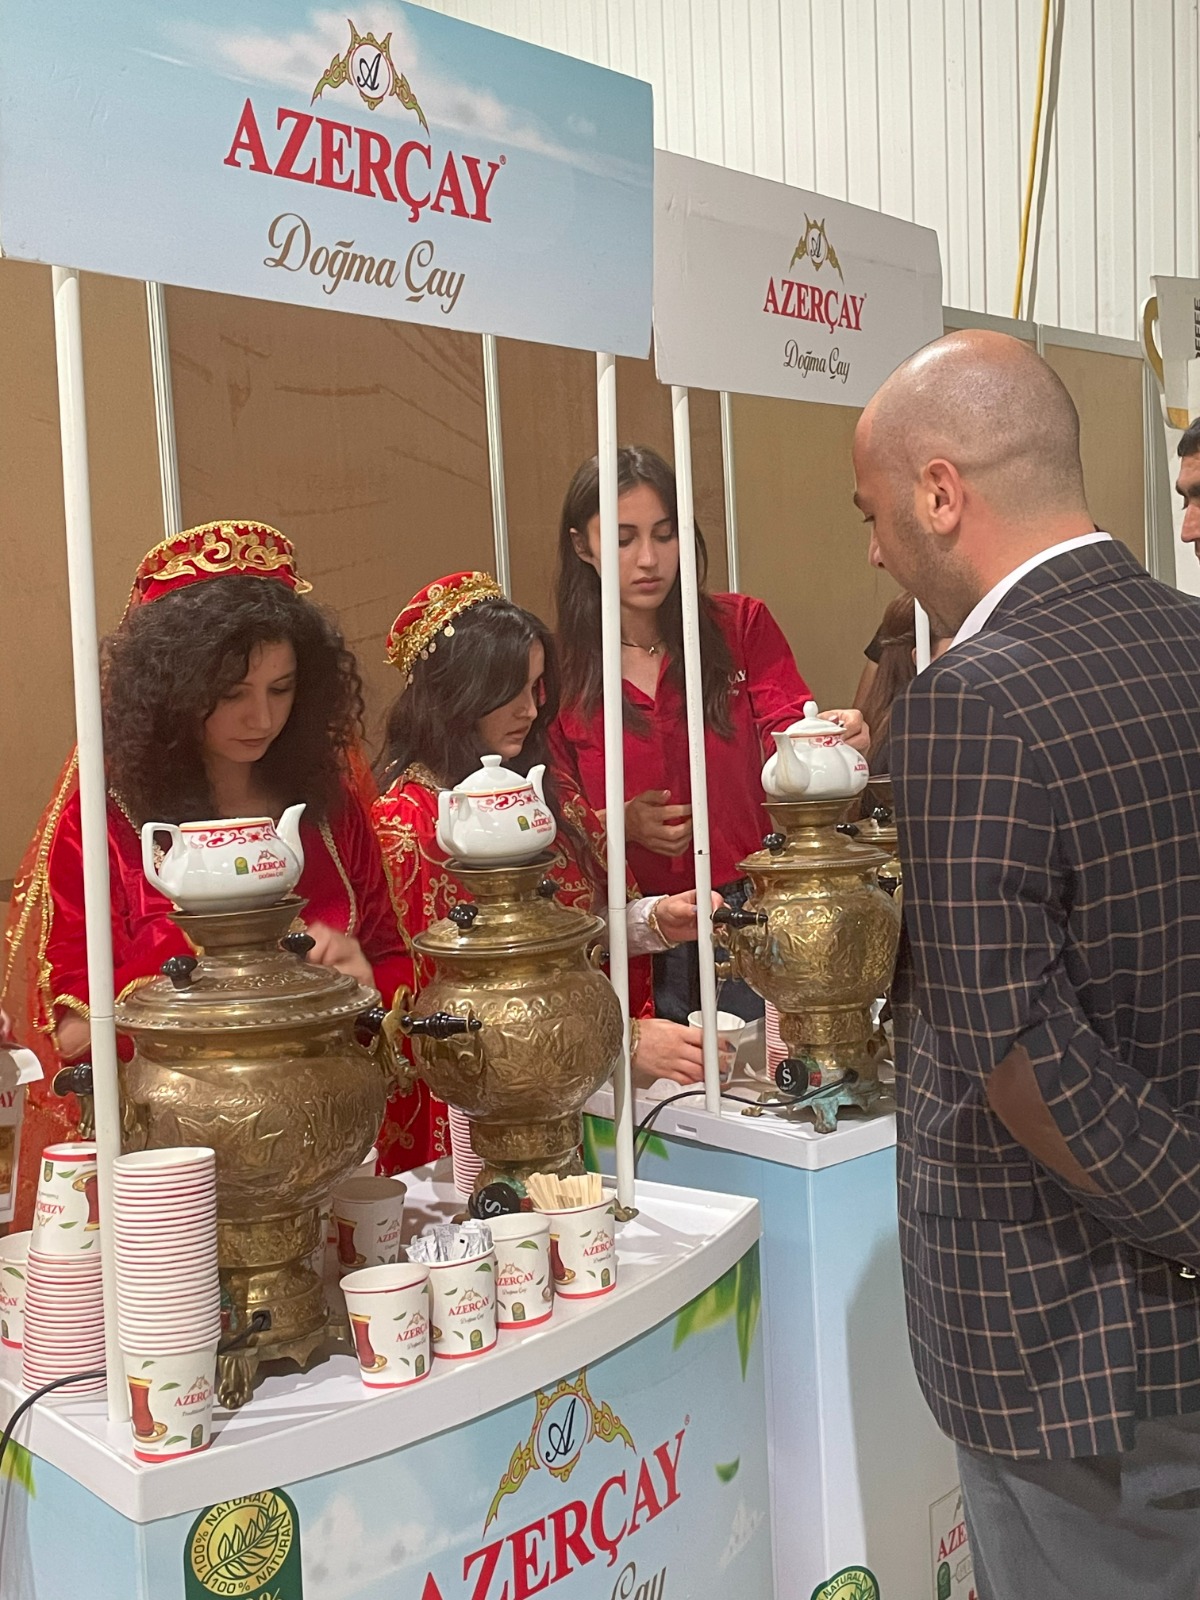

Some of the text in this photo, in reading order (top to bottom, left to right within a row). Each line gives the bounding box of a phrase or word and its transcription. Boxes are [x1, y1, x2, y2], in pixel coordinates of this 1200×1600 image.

[223, 97, 500, 223] AZERÇAY
[263, 213, 465, 314] Doğma Çay
[763, 276, 865, 334] AZERÇAY
[783, 339, 851, 384] Doğma Çay
[210, 1519, 291, 1595] 100% NATURAL
[822, 1572, 863, 1599] NATURAL
